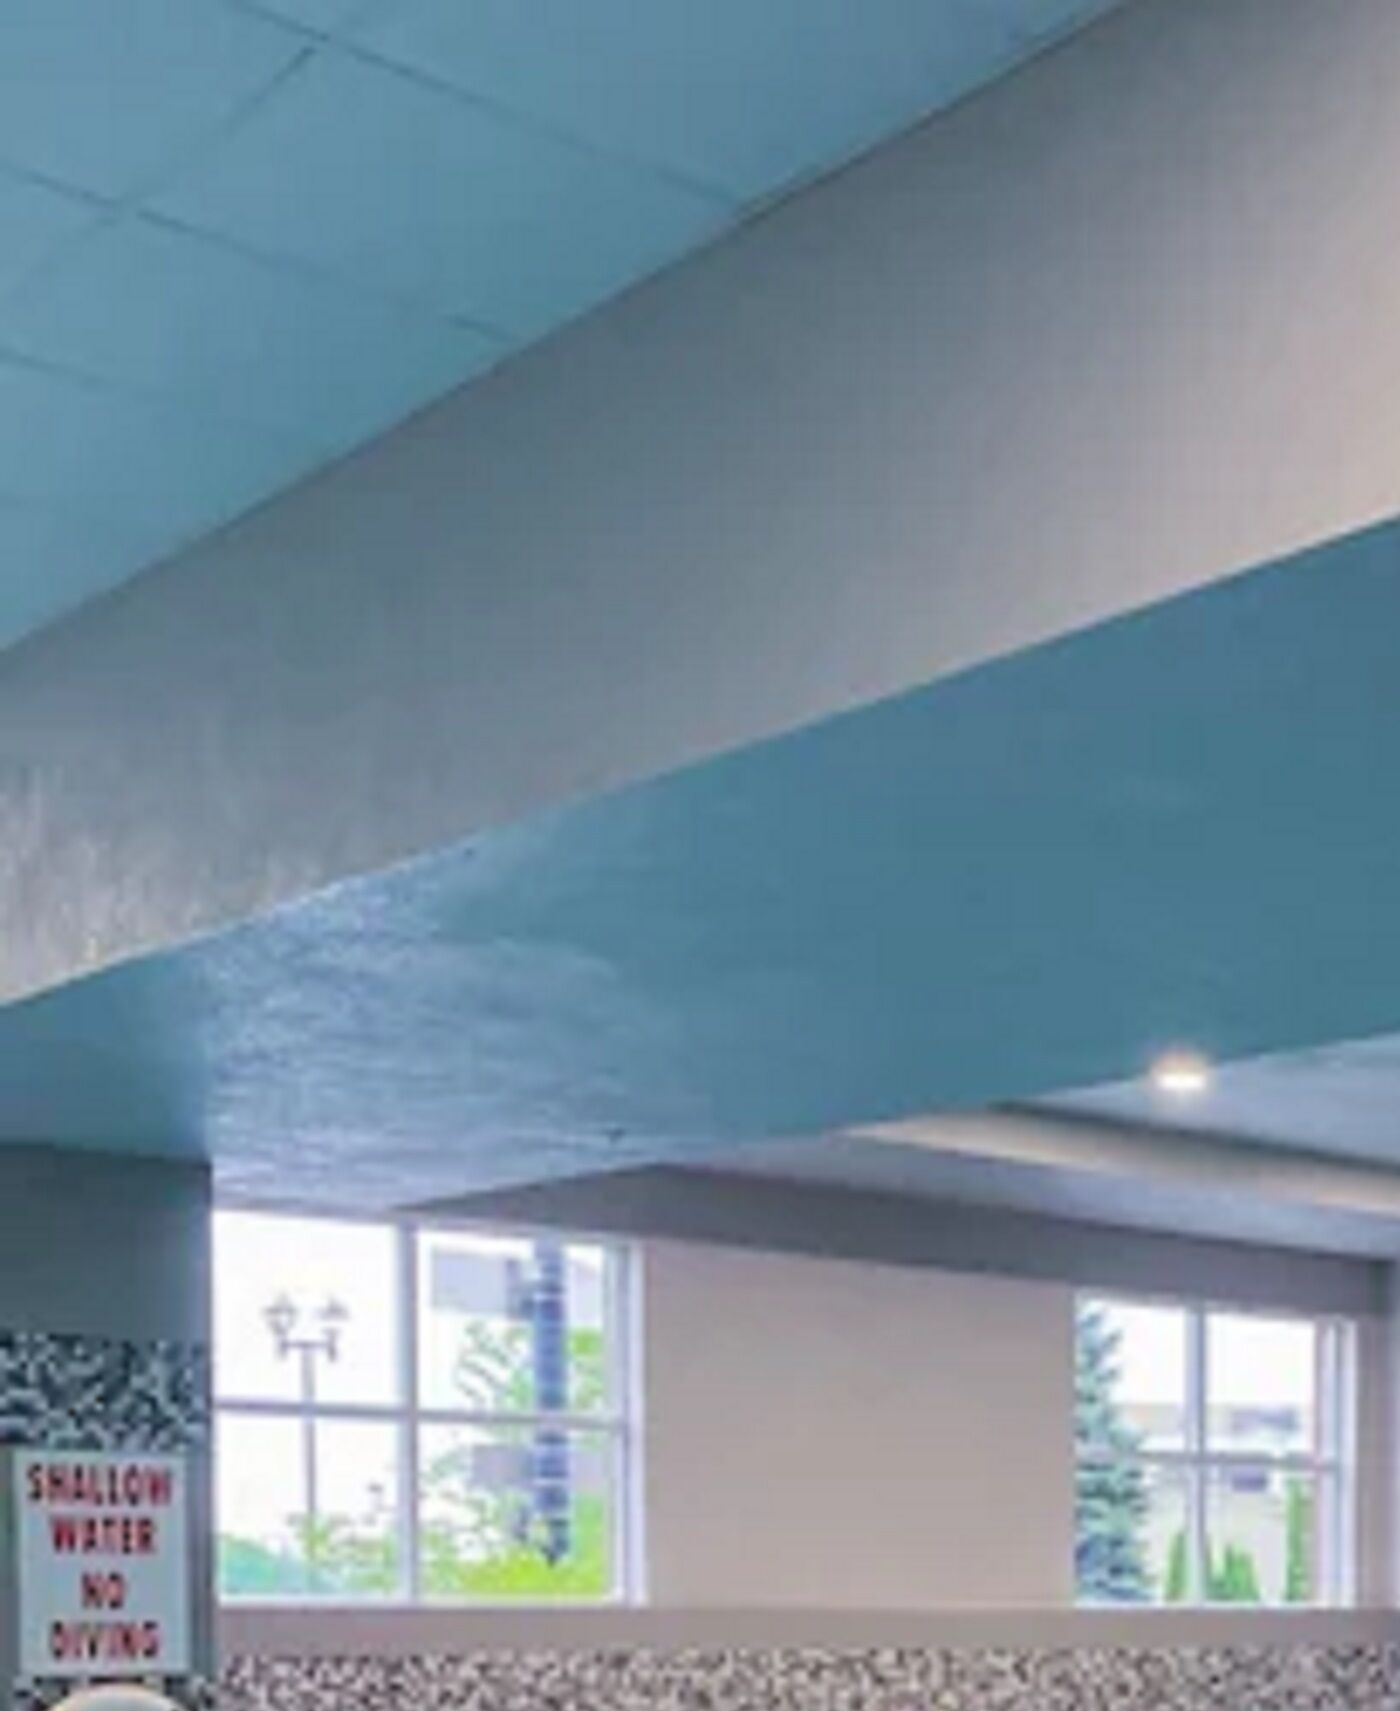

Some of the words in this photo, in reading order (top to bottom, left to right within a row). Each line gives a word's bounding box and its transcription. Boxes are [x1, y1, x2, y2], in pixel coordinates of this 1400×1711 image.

[27, 1463, 171, 1506] SHALLOW
[51, 1516, 155, 1554] WATER
[81, 1571, 124, 1609] NO
[50, 1621, 158, 1659] DIVING
